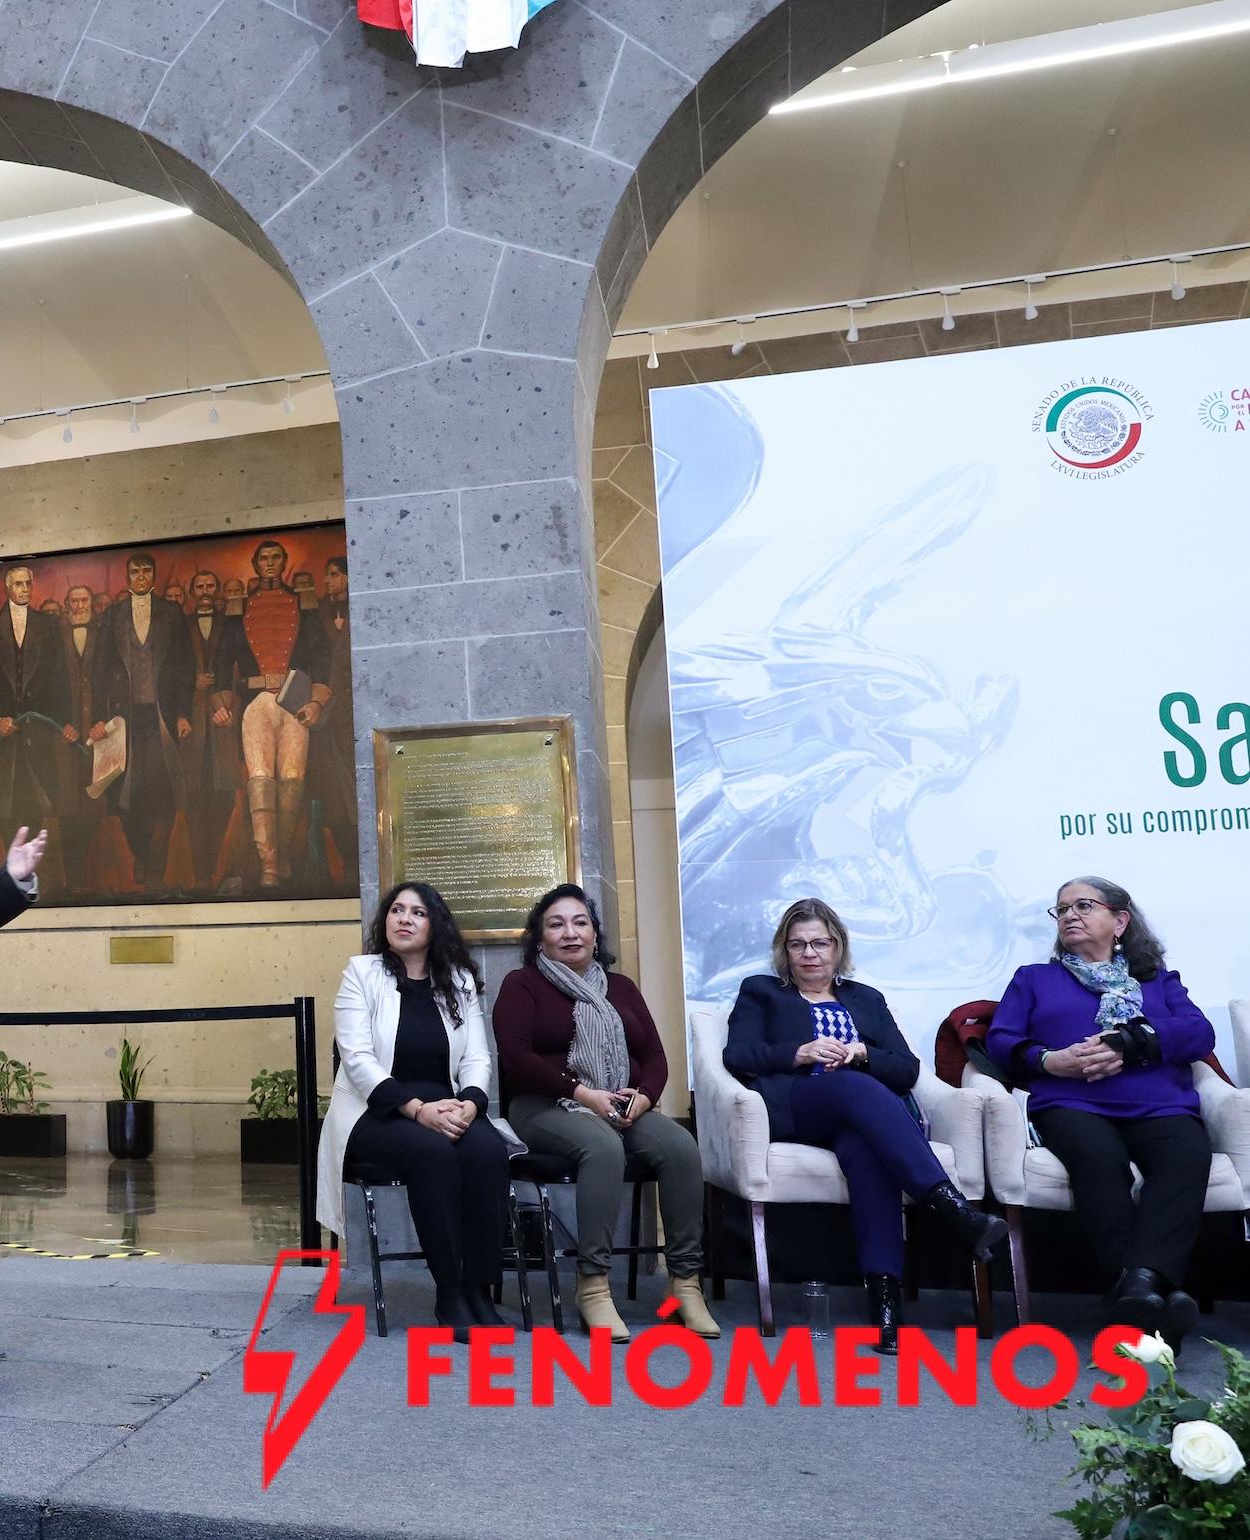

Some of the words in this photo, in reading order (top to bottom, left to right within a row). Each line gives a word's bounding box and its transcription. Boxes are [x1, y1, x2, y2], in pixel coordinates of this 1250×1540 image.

[1032, 390, 1059, 432] SENADO
[1060, 379, 1077, 392] DE
[1081, 376, 1097, 385] LA
[1102, 376, 1154, 421] REPÚBLICA
[1235, 419, 1246, 431] A
[1050, 460, 1074, 477] LXVI
[1075, 451, 1145, 480] LEGISLATURA
[1158, 691, 1250, 788] Sa
[1060, 813, 1097, 840] por
[1106, 812, 1132, 835] su
[1142, 807, 1250, 835] comprom
